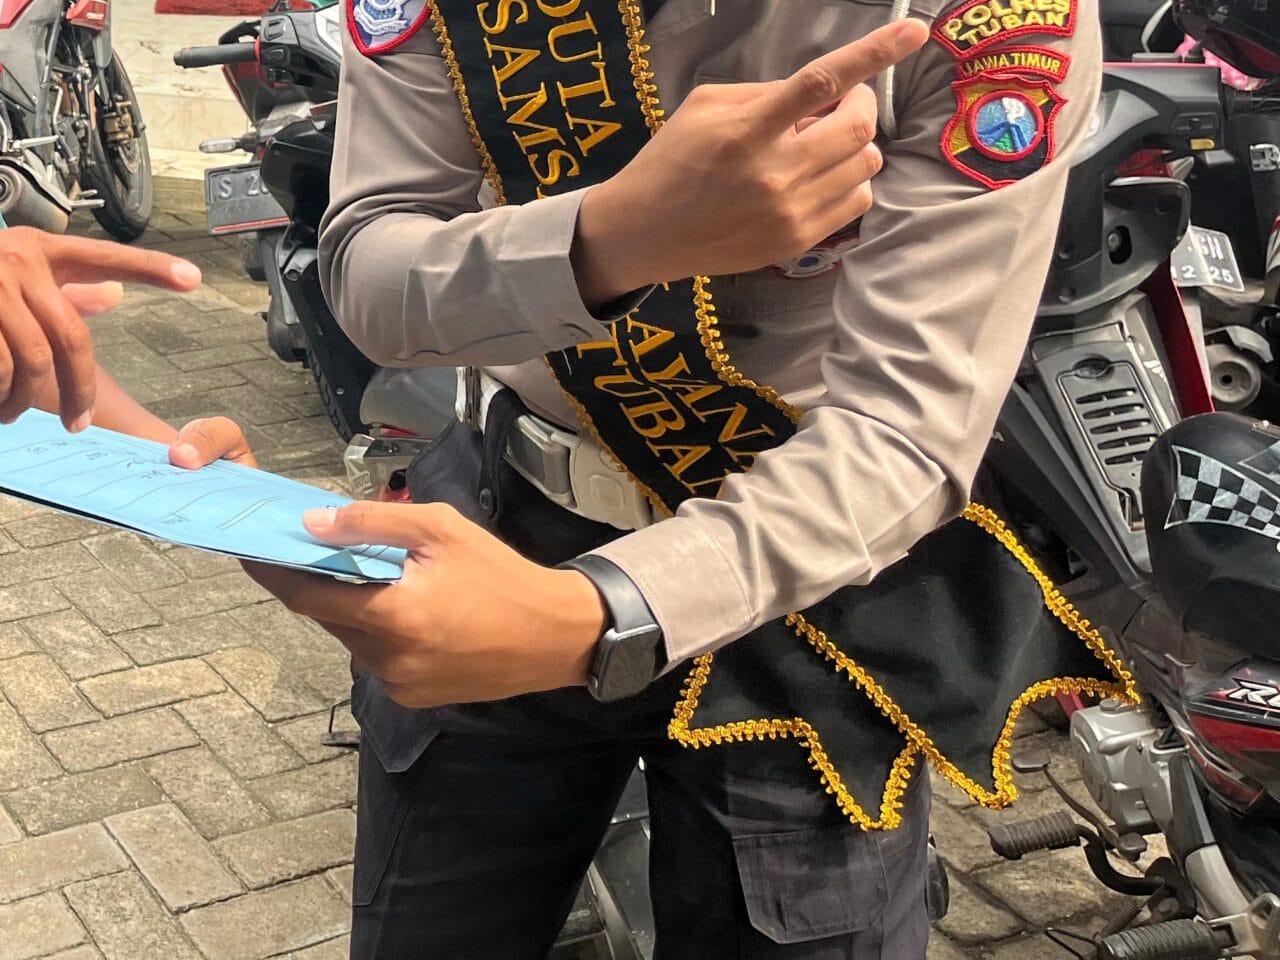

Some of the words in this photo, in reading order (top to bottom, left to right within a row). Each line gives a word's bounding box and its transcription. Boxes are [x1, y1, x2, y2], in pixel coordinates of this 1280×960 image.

[958, 10, 1067, 45] TUBAN
[964, 53, 1010, 77] JAWA
[1011, 52, 1061, 74] TIMUR
[627, 283, 777, 462] AYAN
